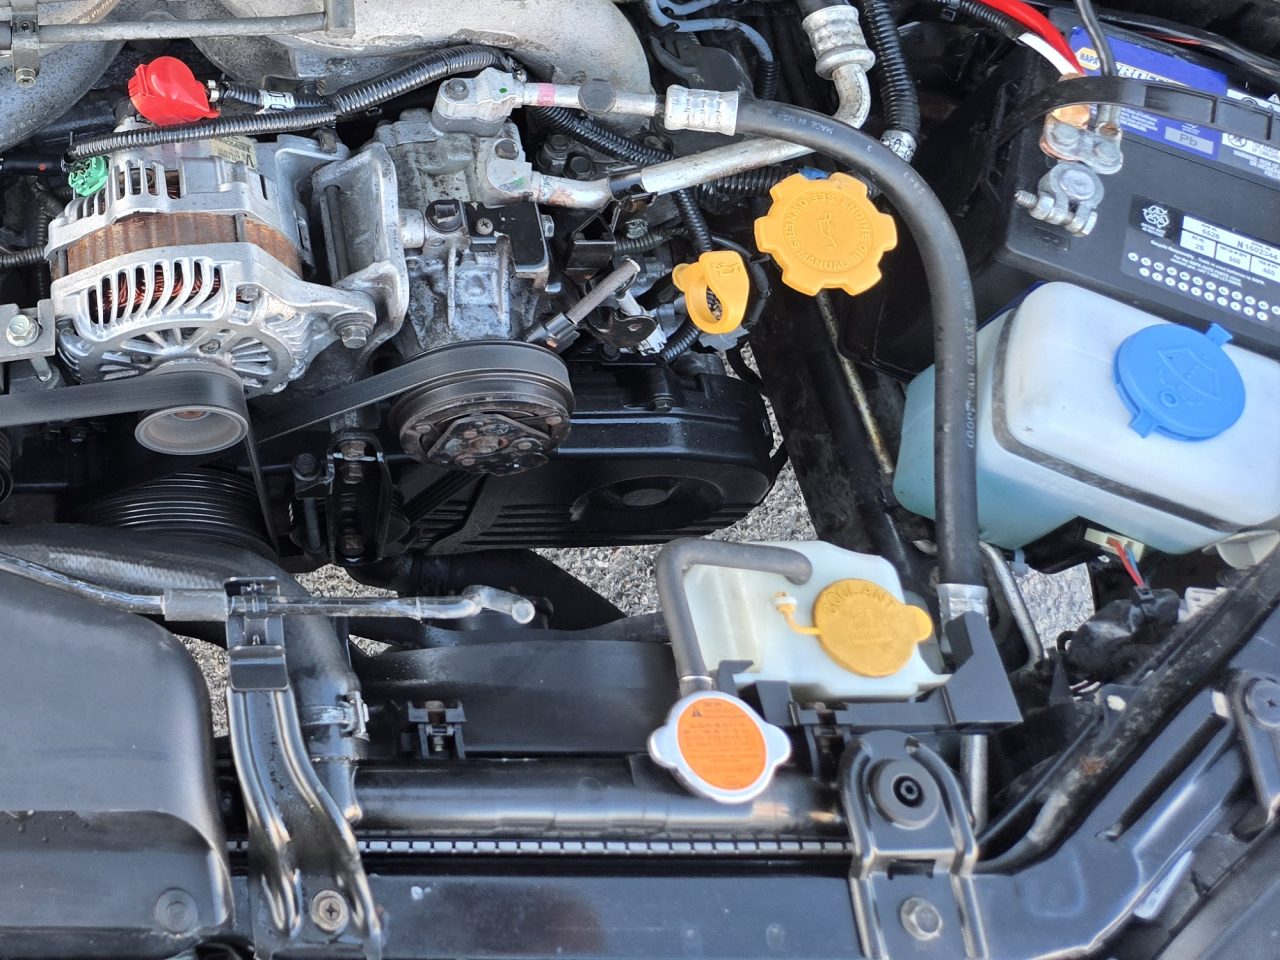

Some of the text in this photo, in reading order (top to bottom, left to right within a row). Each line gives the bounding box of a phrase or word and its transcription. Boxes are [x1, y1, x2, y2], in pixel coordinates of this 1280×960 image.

[1079, 51, 1099, 66] NAPA
[1179, 133, 1198, 147] Pb
[810, 192, 835, 201] SEE
[842, 200, 871, 260] ENGINE OIL
[798, 250, 849, 270] MANUAL
[823, 583, 898, 616] COOLANT
